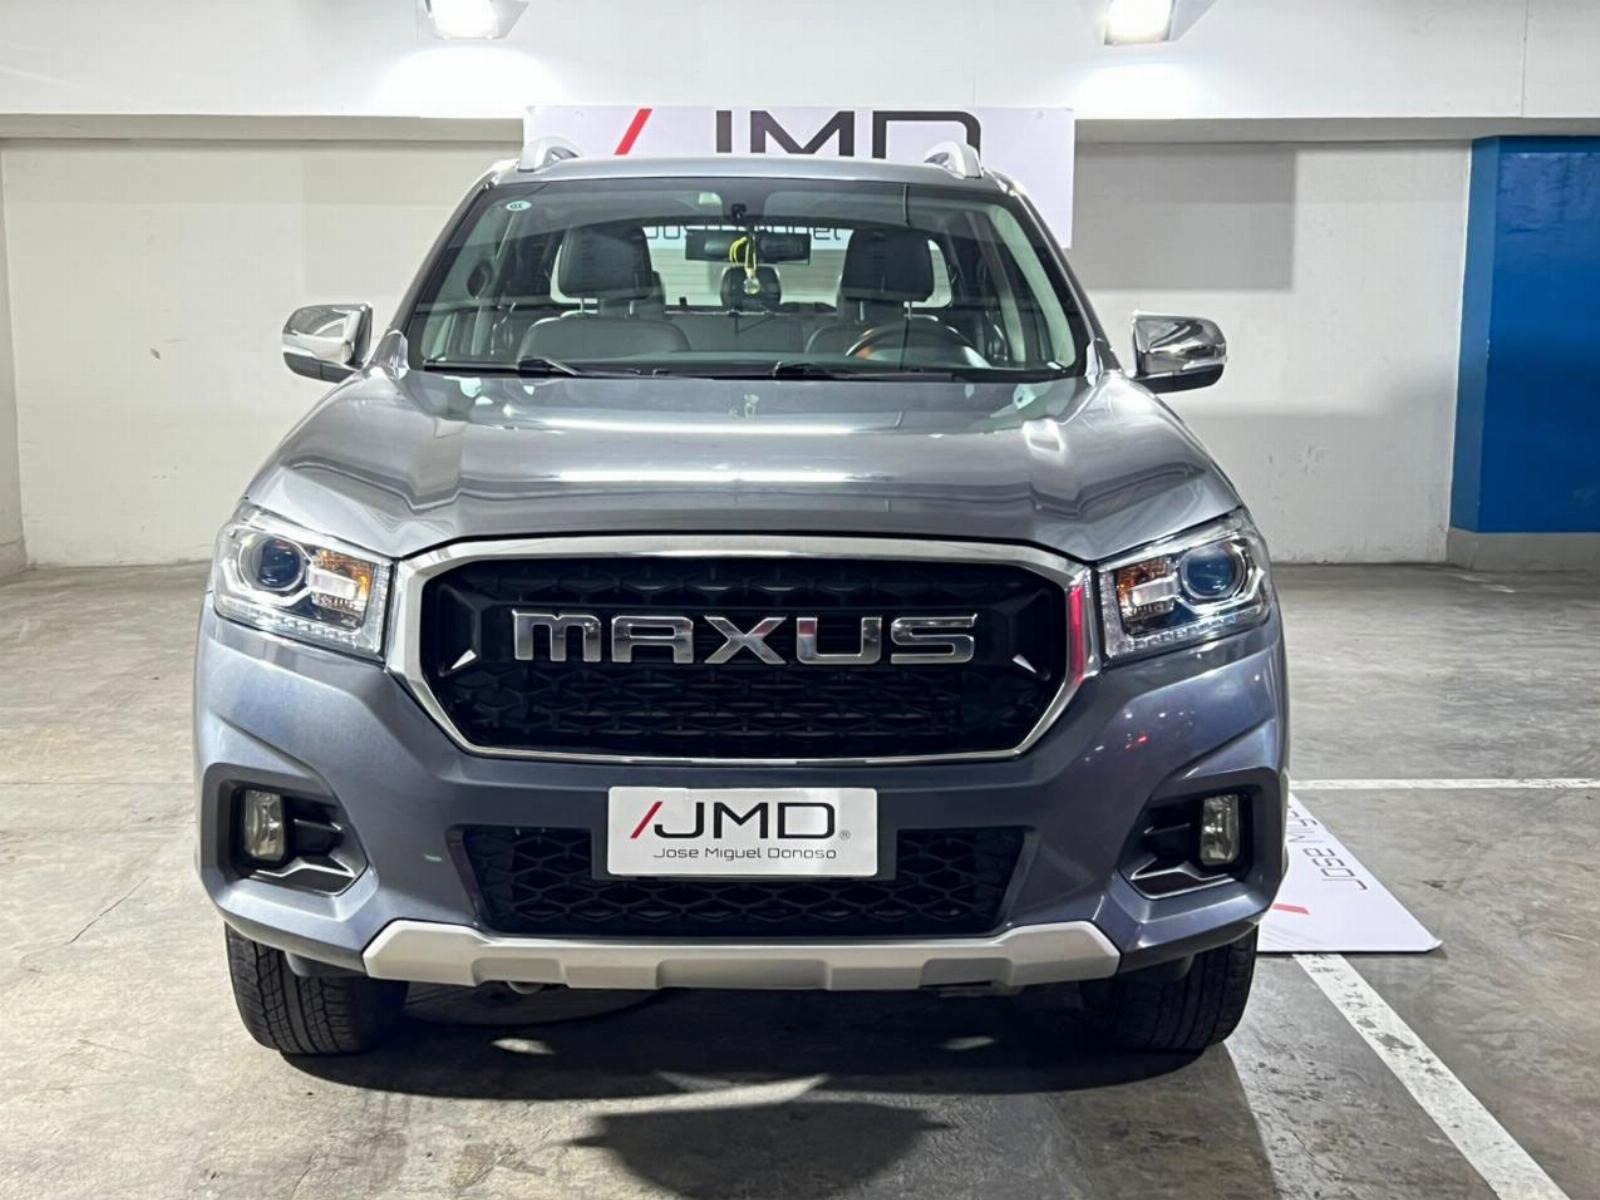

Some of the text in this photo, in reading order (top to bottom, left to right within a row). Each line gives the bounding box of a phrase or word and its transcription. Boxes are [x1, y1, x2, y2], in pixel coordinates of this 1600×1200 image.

[512, 609, 977, 664] MAXUS
[653, 847, 837, 862] Jose Miguel Donoso
